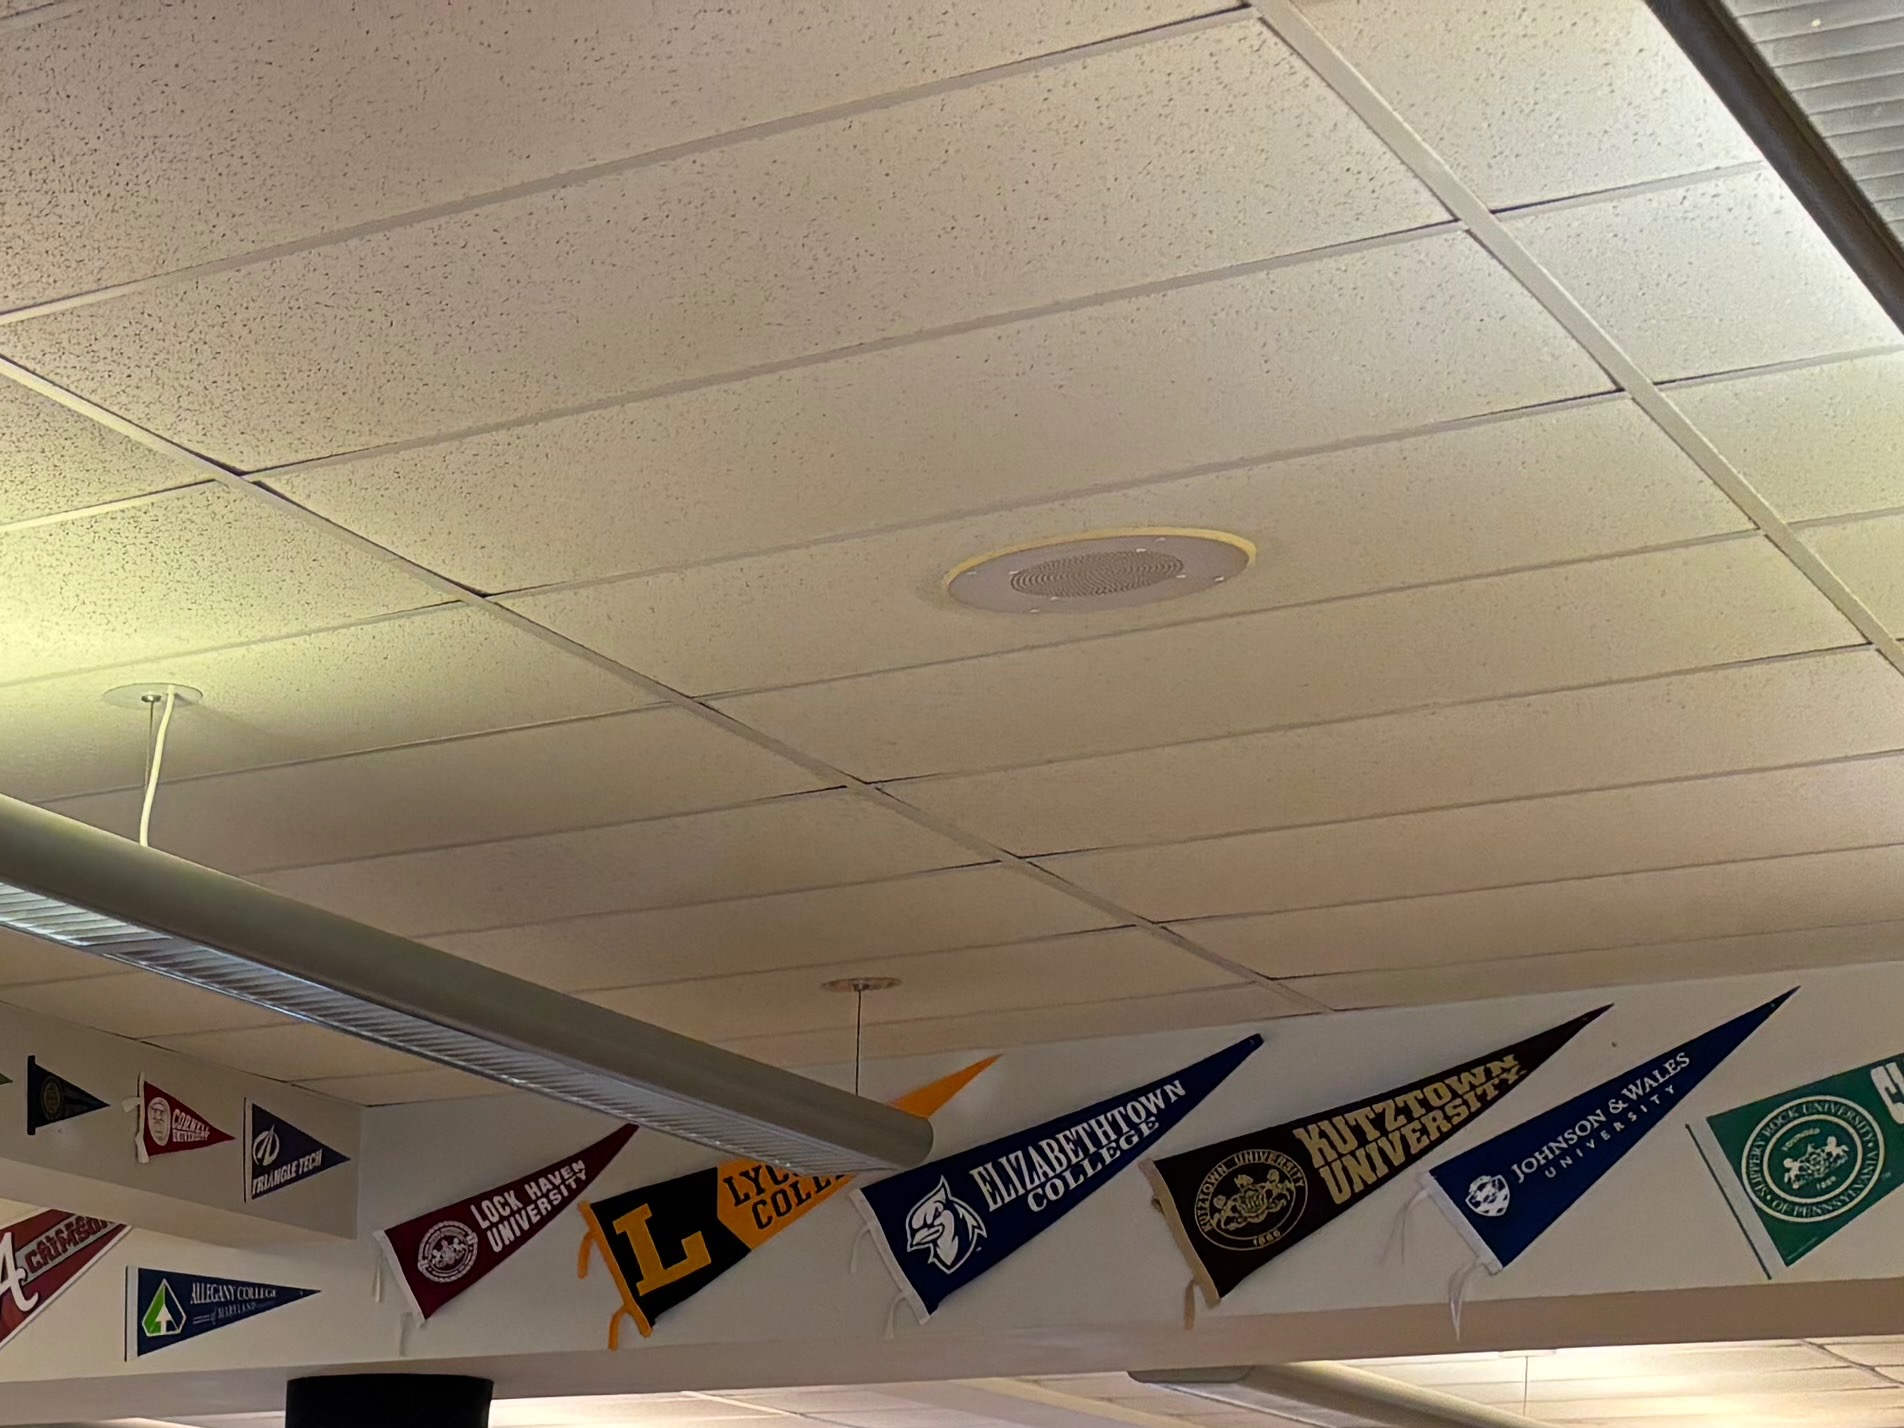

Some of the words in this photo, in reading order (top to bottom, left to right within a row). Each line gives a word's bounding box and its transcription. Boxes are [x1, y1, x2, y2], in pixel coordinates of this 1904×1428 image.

[172, 1109, 210, 1135] CORNELL
[969, 1079, 1187, 1212] ELIZABETHTOWN
[1293, 1054, 1519, 1168] KUTZTOWN
[1319, 1064, 1527, 1205] UNIVERSITY
[1511, 1109, 1607, 1183] JOHNSON
[1608, 1098, 1629, 1114] &
[1621, 1052, 1690, 1101] WALES
[1545, 1084, 1676, 1178] UNIVERSITY
[1764, 1105, 1800, 1138] ROCK
[1802, 1101, 1876, 1143] UNIVERSITY
[252, 1163, 297, 1195] TRIANGLE
[299, 1149, 323, 1174] TECH
[470, 1190, 523, 1229] LOCK
[524, 1160, 586, 1200] HAVEN
[723, 1164, 799, 1207] LYC
[1027, 1117, 1159, 1212] COLLEGE
[1234, 1151, 1304, 1187] UNIVERSITY
[487, 1169, 586, 1252] UNIVERSITY
[751, 1174, 846, 1230] COLL
[1772, 1199, 1792, 1215] OF
[612, 1203, 712, 1296] L
[191, 1282, 235, 1304] ALLEGANY
[237, 1286, 277, 1301] COLLEGE
